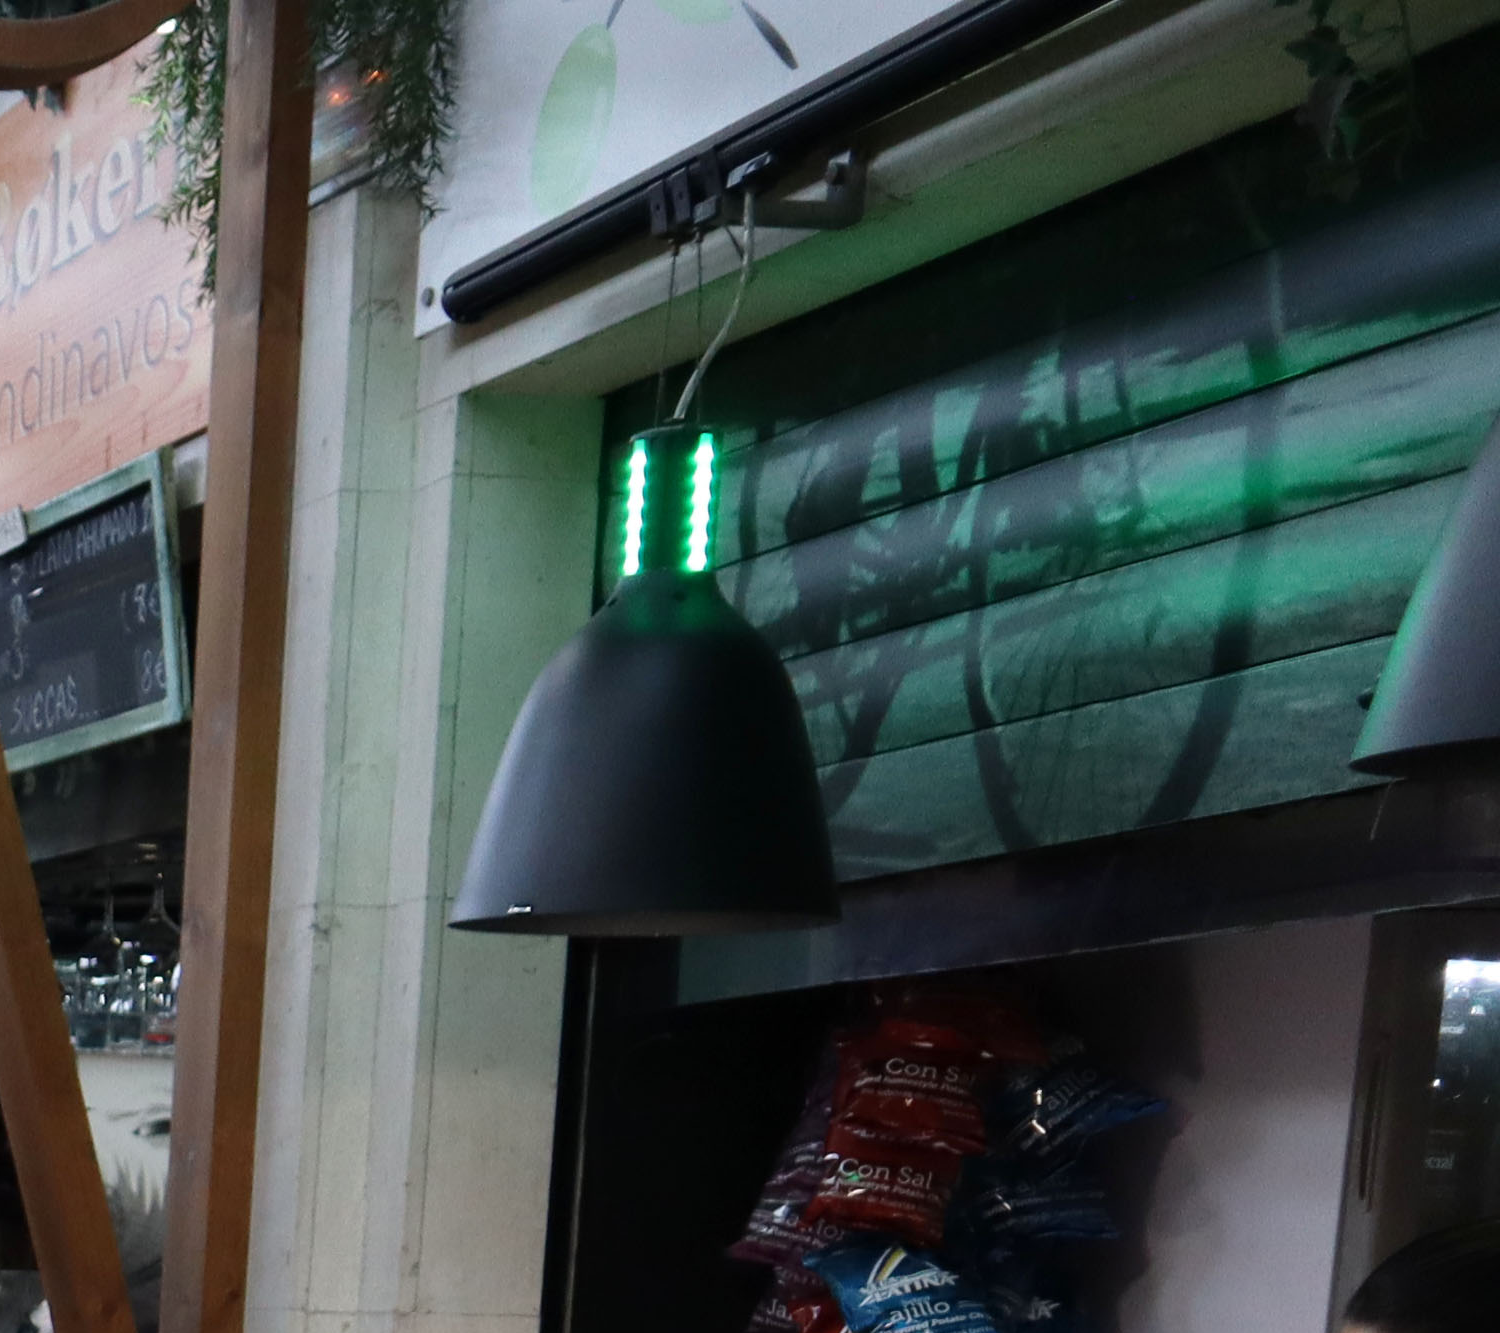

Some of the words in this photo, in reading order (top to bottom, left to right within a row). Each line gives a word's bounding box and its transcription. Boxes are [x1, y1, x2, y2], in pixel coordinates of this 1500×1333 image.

[885, 1057, 938, 1080] Con
[838, 1157, 890, 1181] Con
[899, 1164, 933, 1190] Sal
[889, 1300, 951, 1324] ajillo
[931, 1313, 967, 1327] Potato
